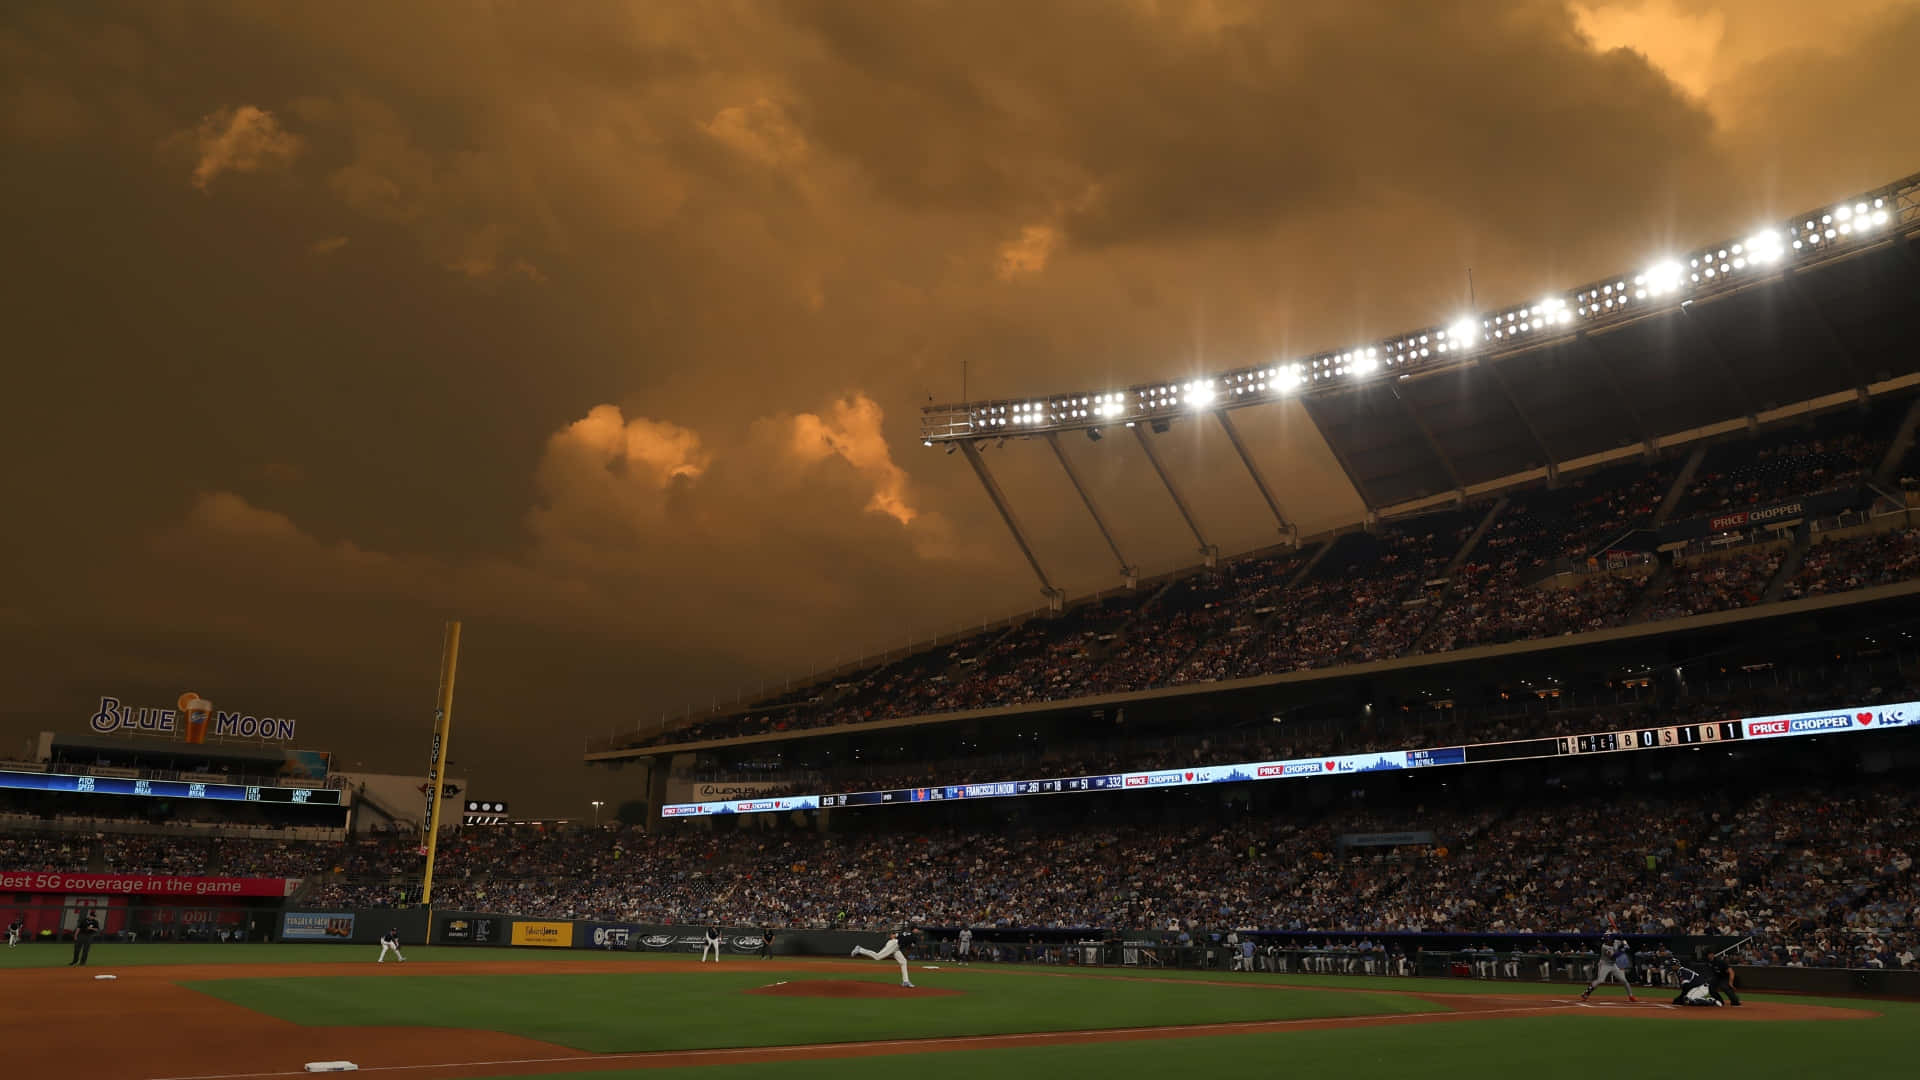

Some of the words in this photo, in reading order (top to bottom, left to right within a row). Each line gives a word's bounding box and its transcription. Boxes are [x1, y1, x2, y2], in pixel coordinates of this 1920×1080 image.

[1712, 515, 1745, 529] PRICE
[1750, 504, 1803, 521] CHOPPER
[91, 697, 175, 733] BLUE
[216, 710, 295, 740] MOON
[1752, 722, 1785, 734] PRICE
[1791, 716, 1848, 730] CHOPPER
[1879, 711, 1904, 725] KC
[1664, 731, 1672, 743] S
[1685, 728, 1692, 742] 1
[1728, 723, 1735, 738] 1
[1259, 766, 1282, 776] PRICE
[1284, 763, 1320, 773] CHOPPER
[1127, 777, 1147, 785] PRICE
[1149, 775, 1181, 784] CHOPPER
[35, 875, 61, 889] 5G
[65, 879, 144, 893] coverage
[147, 877, 162, 891] in
[167, 878, 193, 891] the
[196, 882, 242, 894] game
